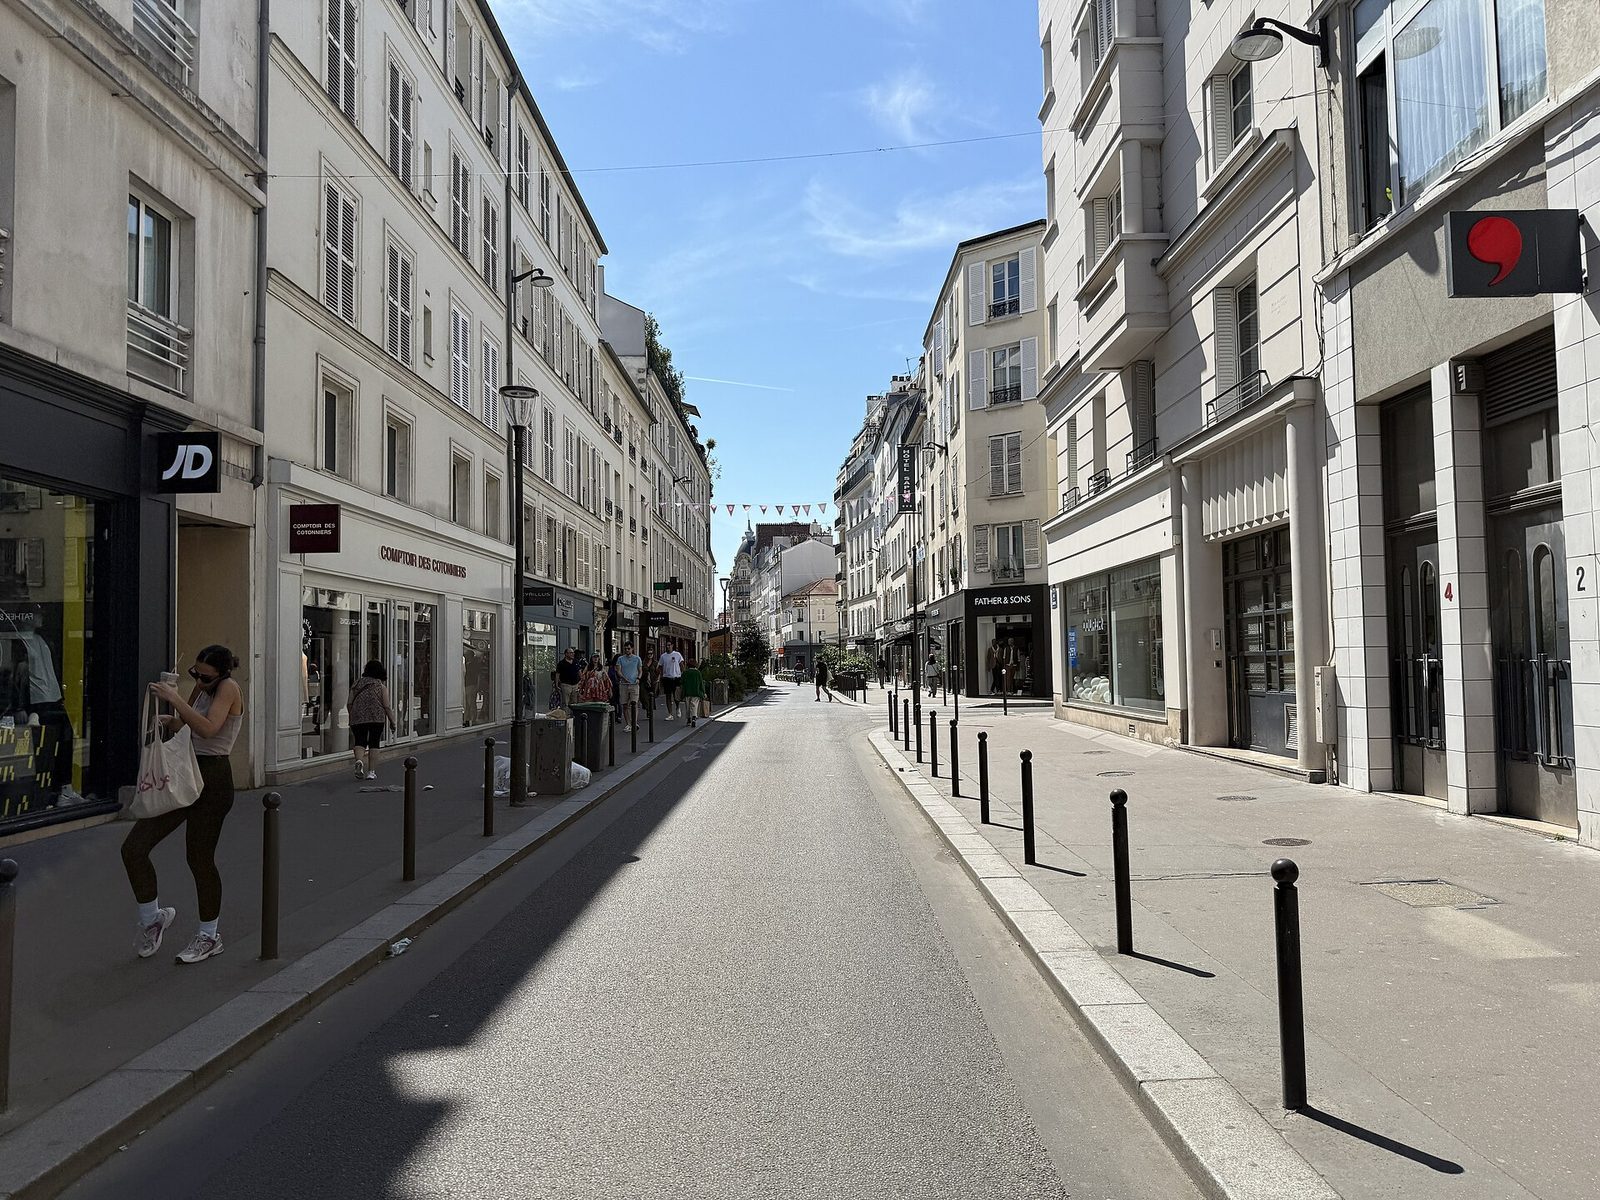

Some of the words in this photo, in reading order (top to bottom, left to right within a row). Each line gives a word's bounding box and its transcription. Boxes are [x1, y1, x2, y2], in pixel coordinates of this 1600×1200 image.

[162, 443, 213, 480] JD
[292, 522, 322, 530] COMPTOIR
[380, 545, 417, 567] COMPTOIR
[418, 555, 431, 570] DES
[432, 559, 467, 578] COTONNIERS
[1576, 566, 1586, 592] 2
[974, 597, 1003, 605] FATHER
[1003, 597, 1009, 605] &
[1010, 595, 1031, 604] SONS
[1444, 582, 1453, 602] 4
